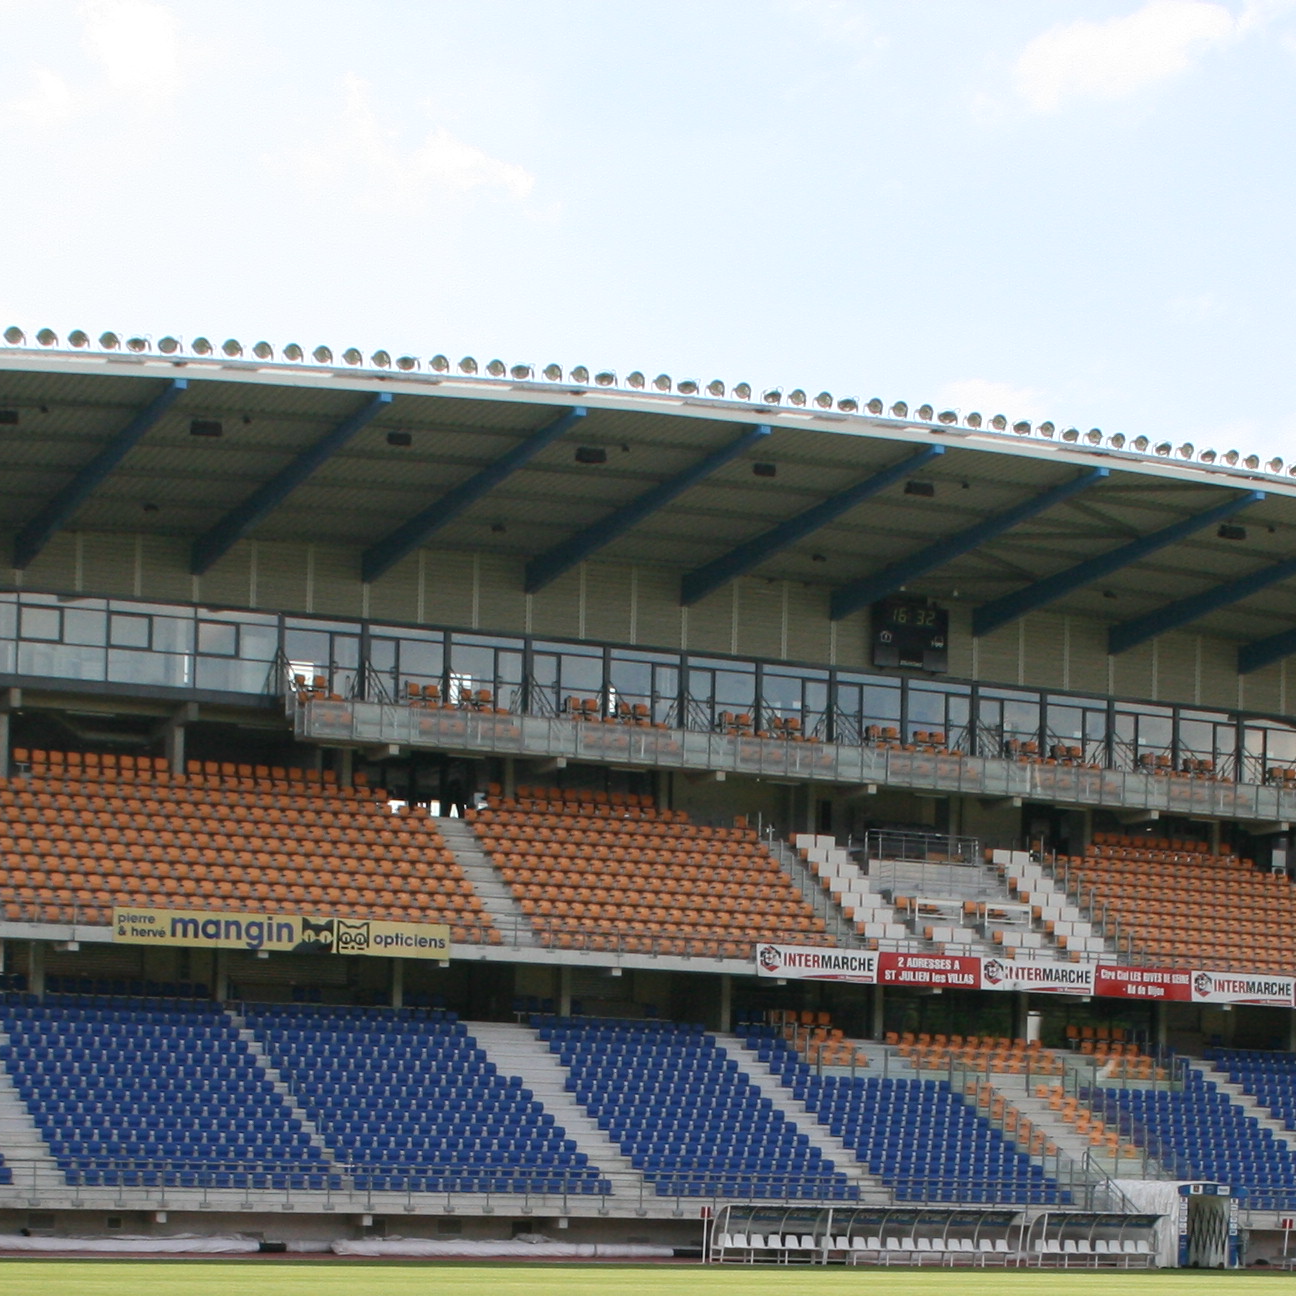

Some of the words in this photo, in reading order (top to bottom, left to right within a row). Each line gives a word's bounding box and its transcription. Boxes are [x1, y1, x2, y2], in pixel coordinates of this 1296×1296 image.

[118, 913, 155, 924] pierre
[118, 926, 126, 936] &
[131, 926, 166, 938] hervé
[171, 916, 294, 949] mangin
[373, 934, 446, 949] opticiens
[784, 952, 874, 972] INTERMARCHE
[897, 957, 905, 967] 2
[906, 957, 951, 970] ADRESSES
[953, 960, 960, 970] A
[884, 970, 897, 980] ST
[899, 971, 930, 982] JULIEN
[932, 973, 946, 983] les
[947, 973, 974, 984] VILLAS
[1006, 966, 1091, 984] INTERMARCHE
[1130, 971, 1142, 982] LES
[1214, 979, 1292, 996] INTERMARCHE
